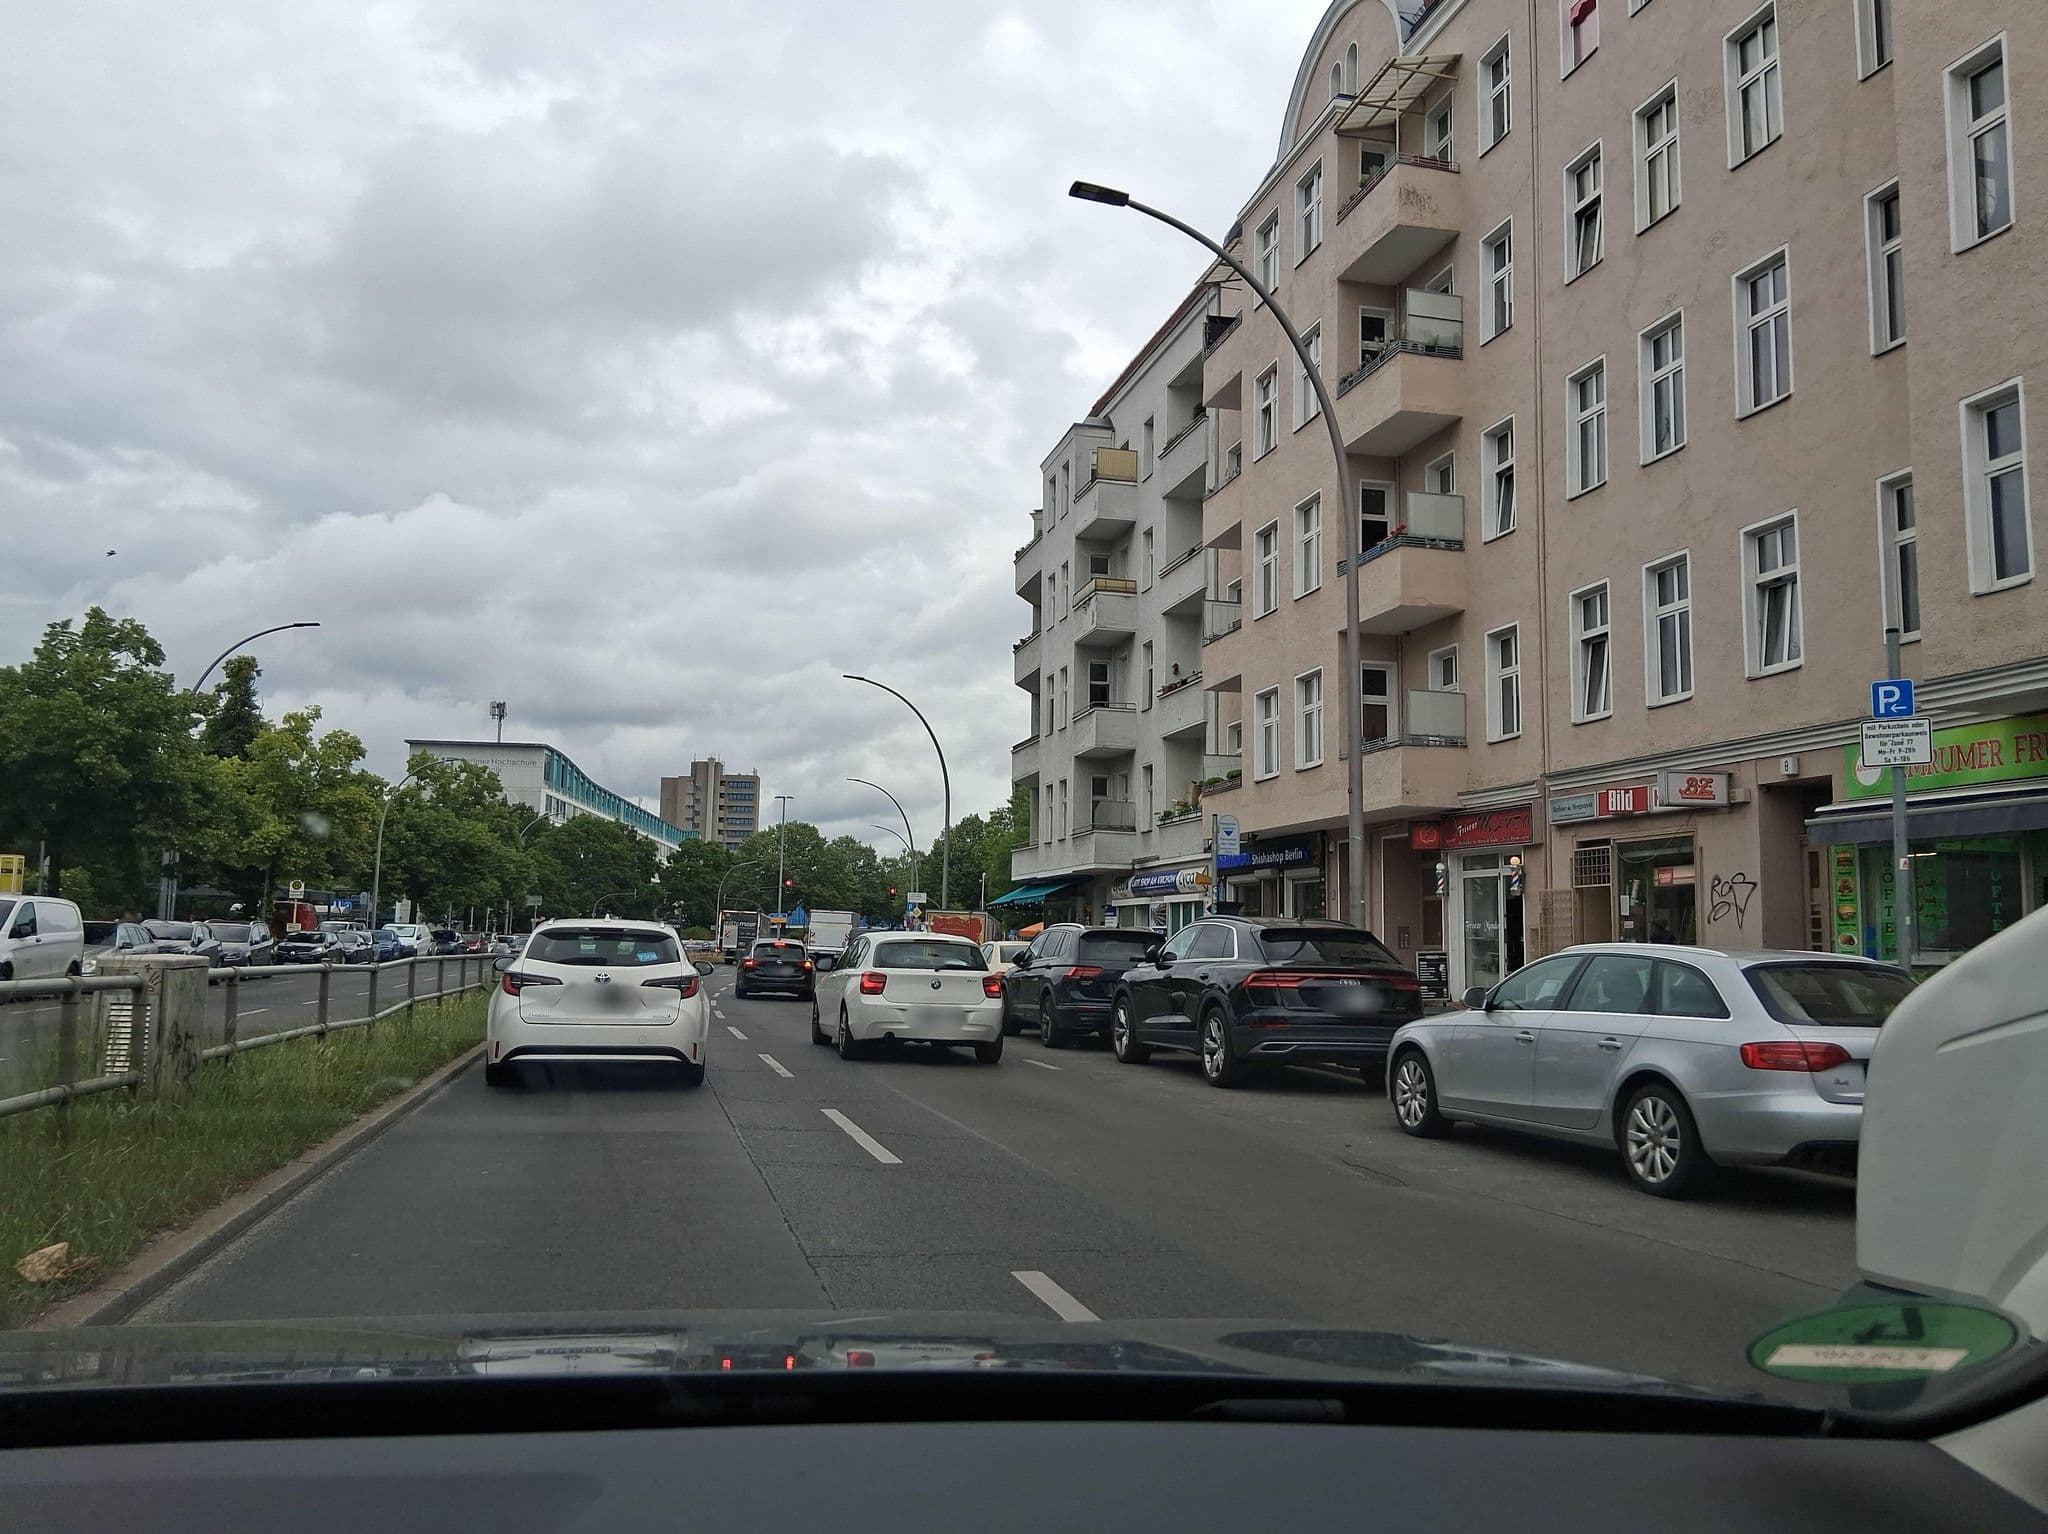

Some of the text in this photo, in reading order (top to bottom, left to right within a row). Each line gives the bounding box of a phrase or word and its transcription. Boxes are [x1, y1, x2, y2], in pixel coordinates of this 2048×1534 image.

[1878, 685, 1901, 714] P
[1878, 722, 1910, 730] Parkschein
[491, 758, 537, 766] Hochschule
[1608, 789, 1633, 811] Bild
[1251, 850, 1284, 865] Shishashop
[1284, 847, 1303, 861] Berlin
